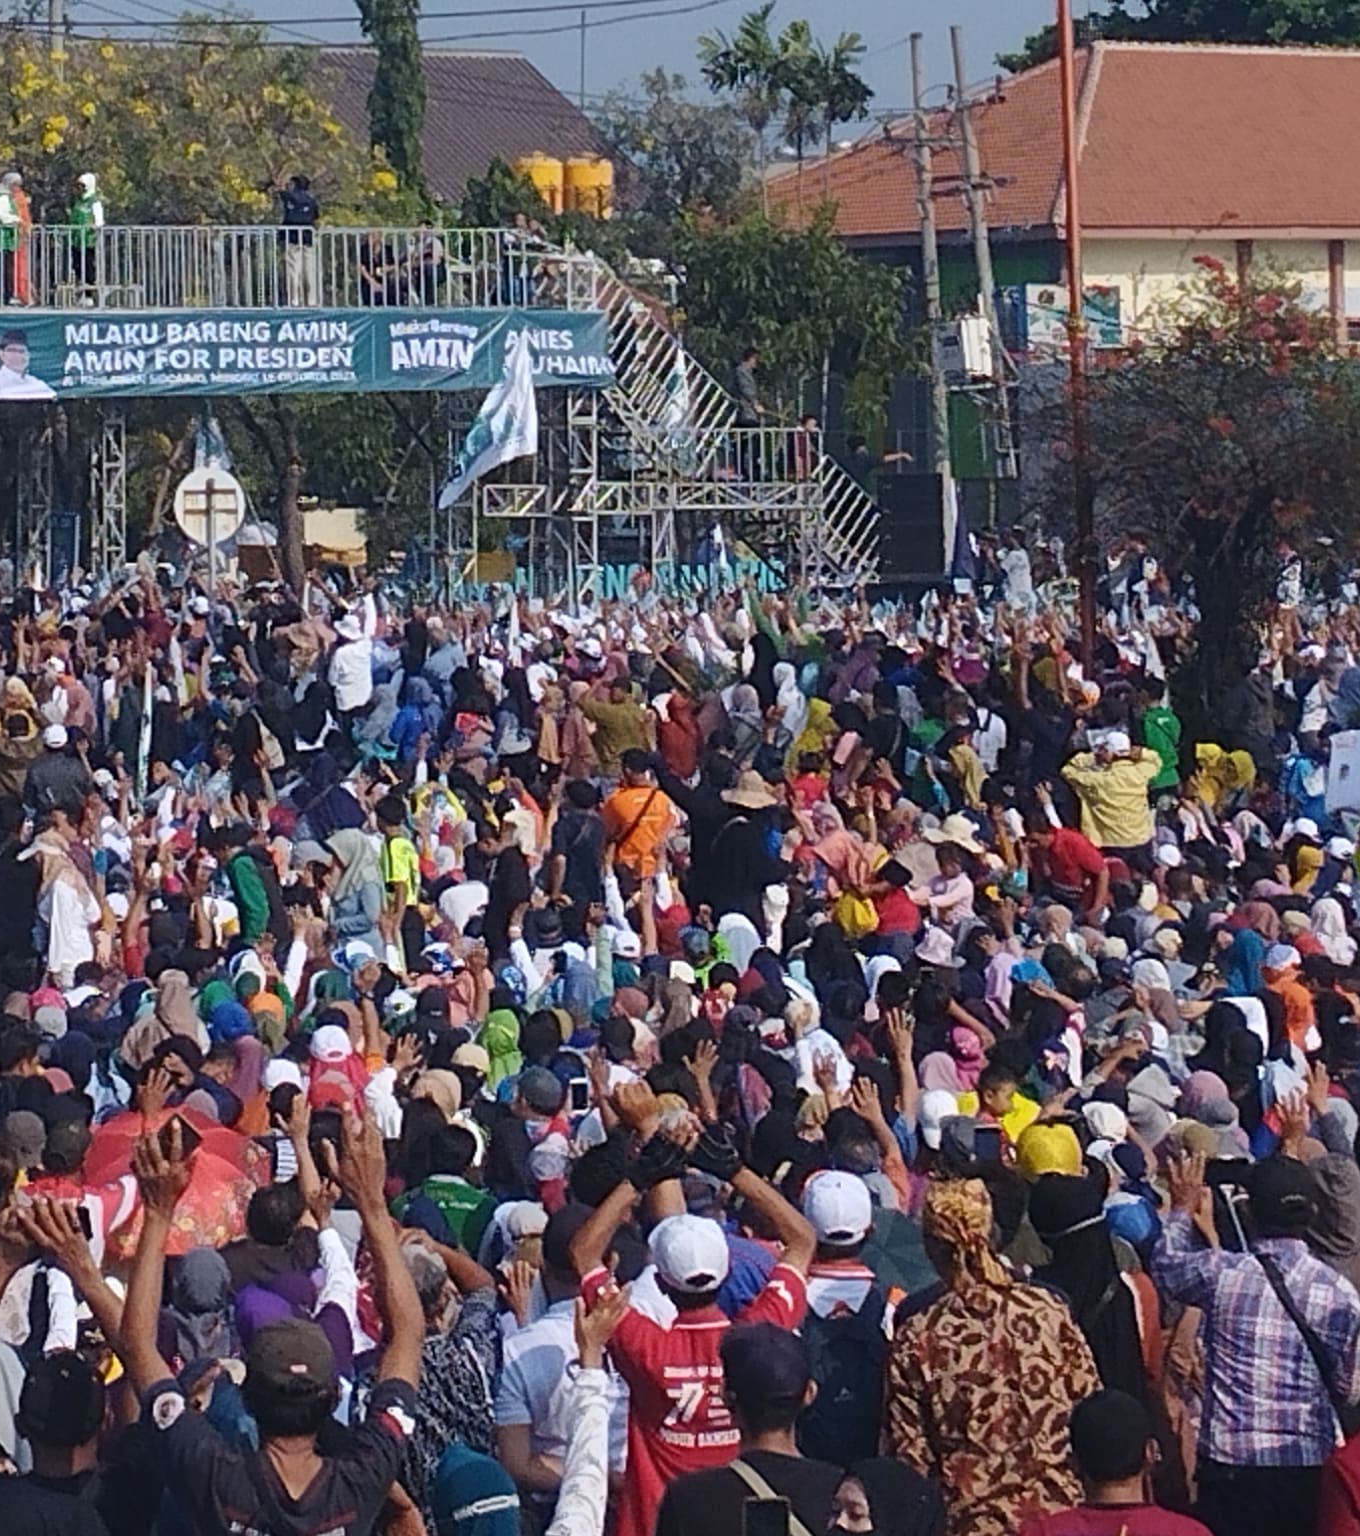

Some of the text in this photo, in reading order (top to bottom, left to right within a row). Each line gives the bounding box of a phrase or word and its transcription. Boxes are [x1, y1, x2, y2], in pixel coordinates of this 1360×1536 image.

[65, 323, 158, 345] MLAKU
[167, 321, 271, 342] BARENG
[504, 329, 574, 350] ANIES
[64, 347, 353, 372] AMIN FOR PRESIDEN
[391, 338, 474, 370] AMIN
